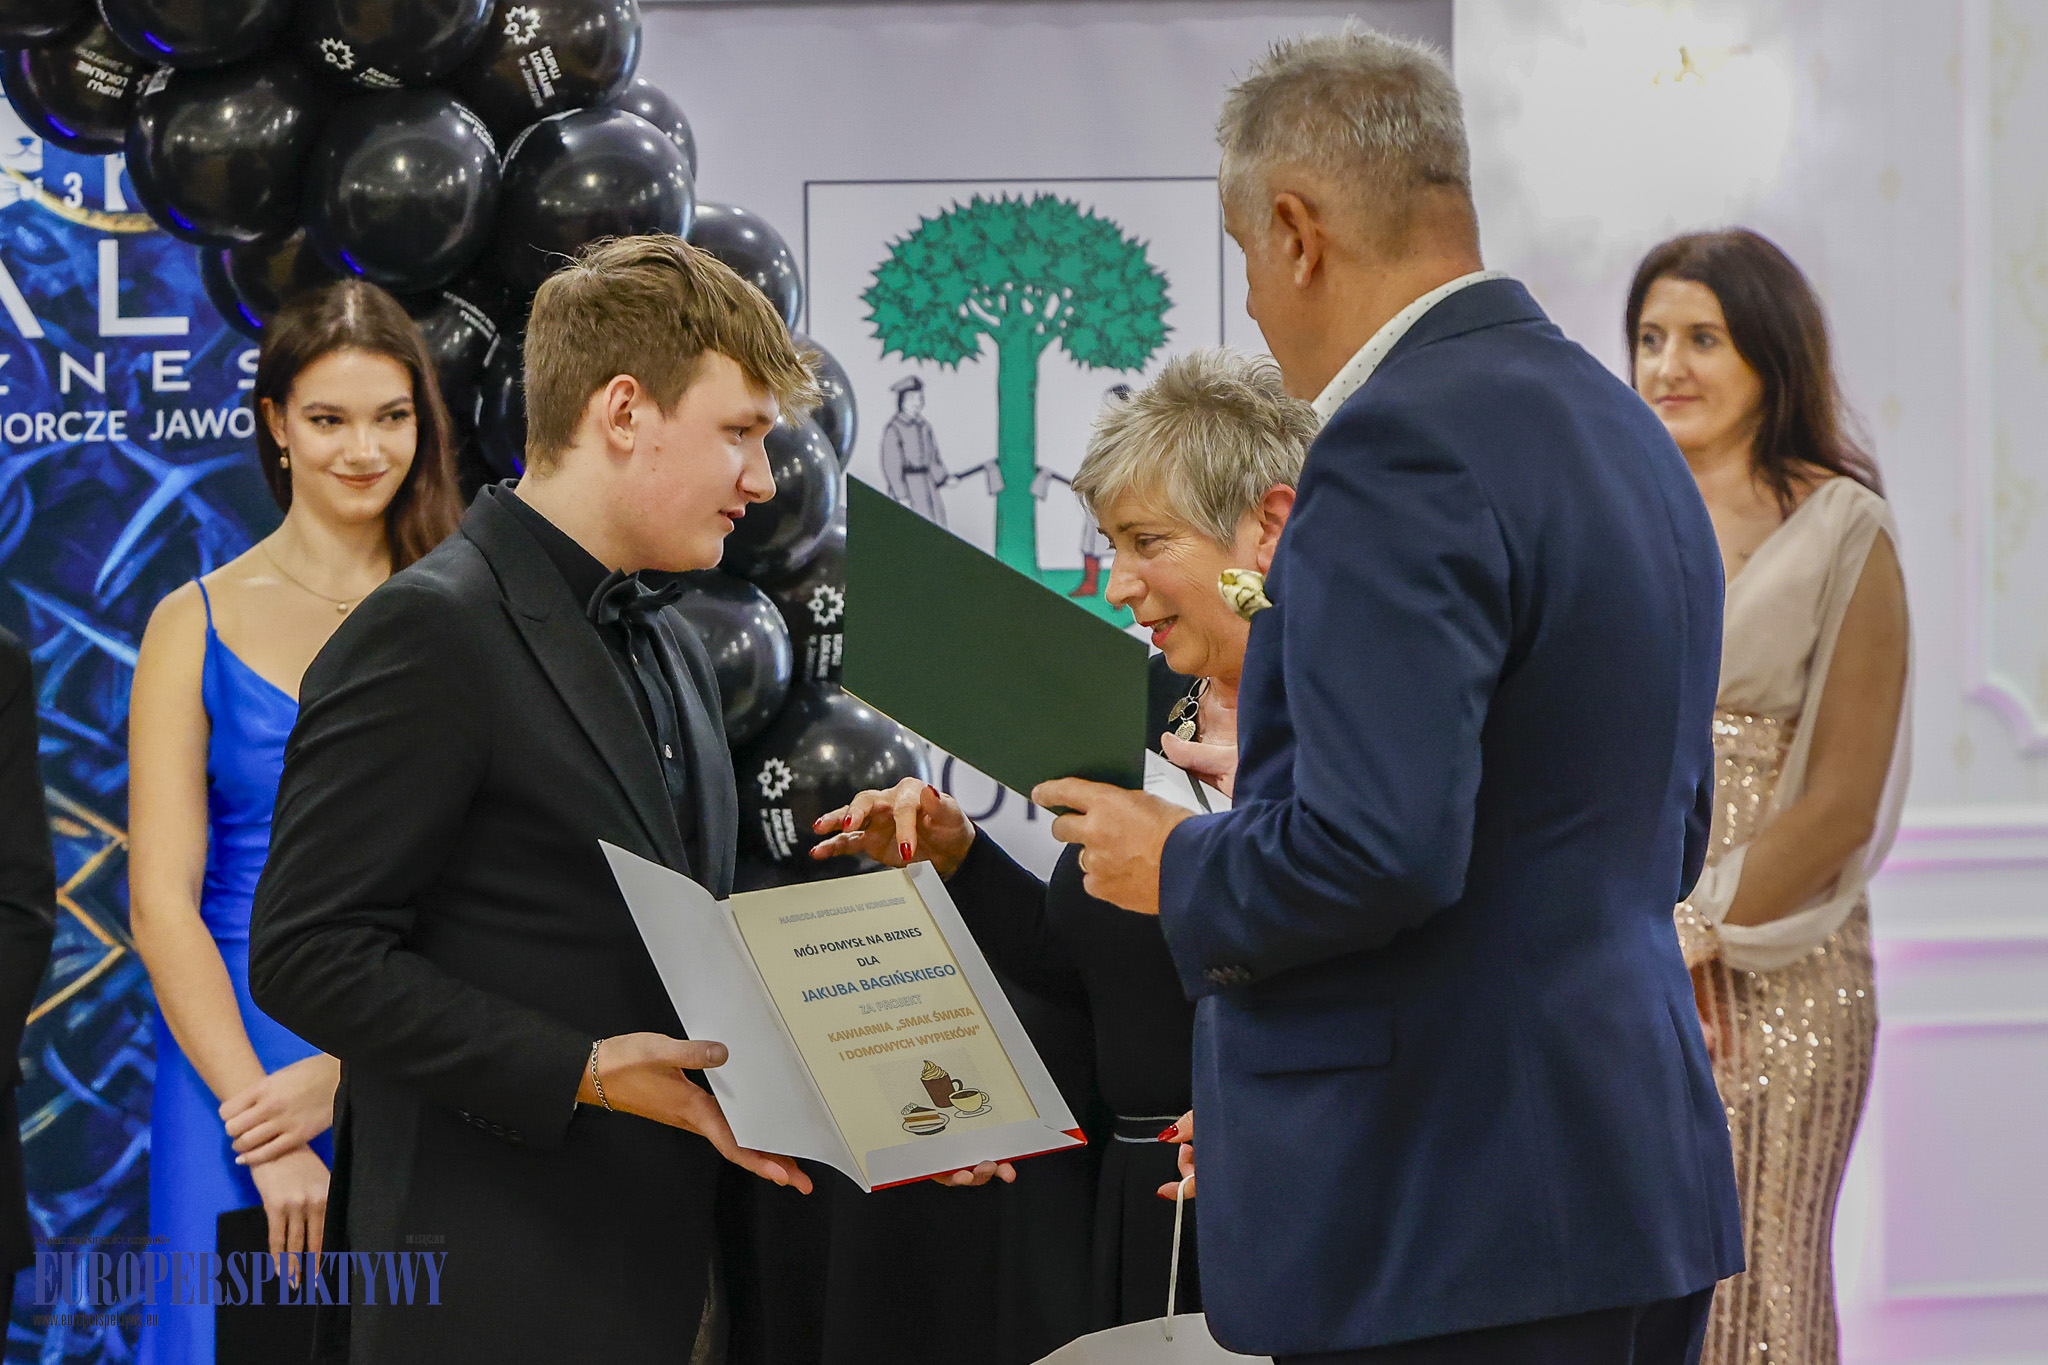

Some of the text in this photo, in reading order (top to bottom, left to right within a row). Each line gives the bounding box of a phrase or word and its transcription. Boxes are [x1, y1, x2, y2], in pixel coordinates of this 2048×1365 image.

[541, 45, 562, 80] KUPUJ
[793, 927, 923, 958] MÓJ POMYSŁ NA BIZNES
[856, 955, 880, 967] DLA
[801, 964, 957, 1003] JAKUBA BAGIŃSKIEGO
[859, 994, 923, 1015] ZA PROJEKT
[827, 1021, 894, 1043] KAWIARNIA
[932, 1007, 975, 1023] ŚWIATA
[838, 1051, 845, 1062] I
[845, 1037, 916, 1061] DOMOWYCH
